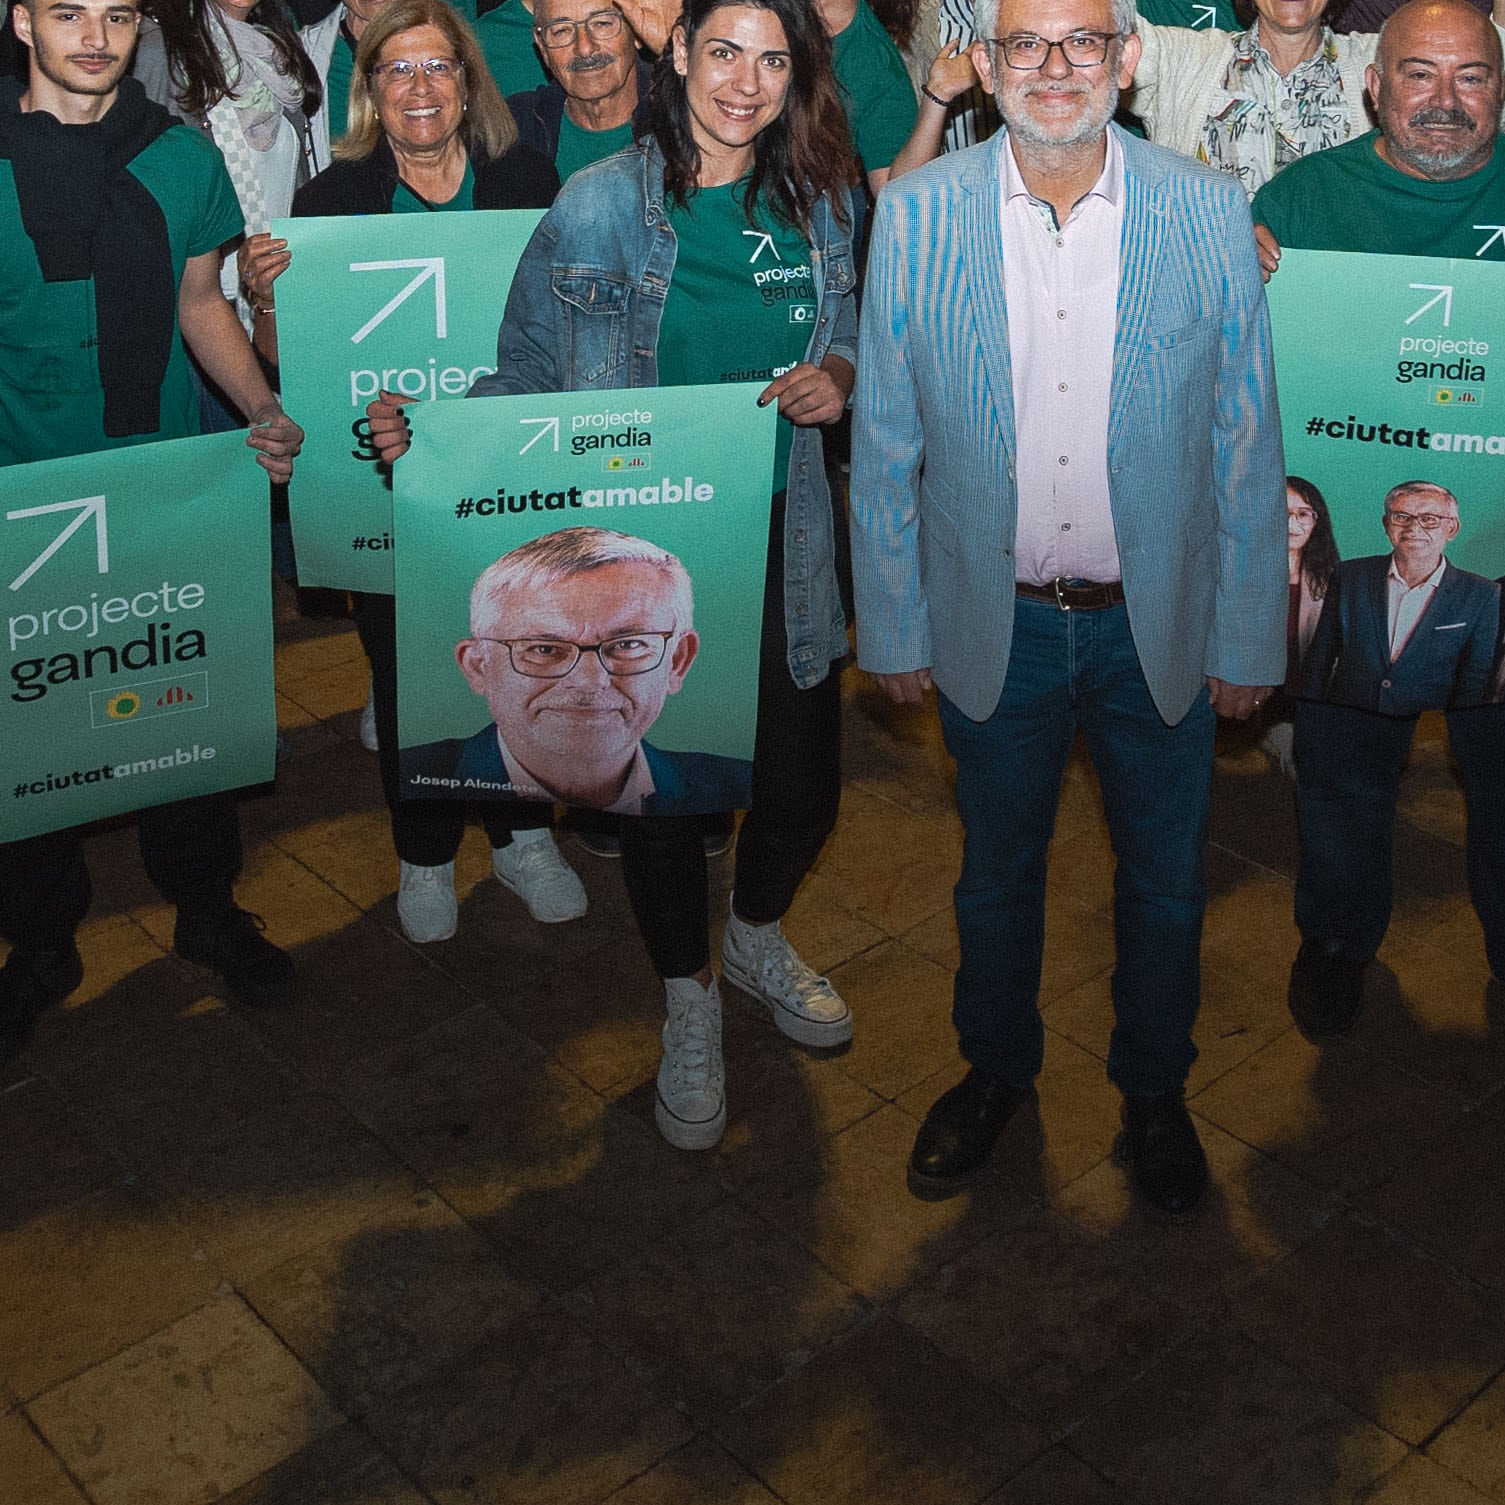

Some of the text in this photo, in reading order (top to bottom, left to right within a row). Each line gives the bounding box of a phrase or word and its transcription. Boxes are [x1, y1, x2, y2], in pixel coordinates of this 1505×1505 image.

[1399, 334, 1490, 362] projecte
[350, 357, 495, 407] projec
[1395, 357, 1486, 384] gandia
[571, 408, 653, 434] projecte
[570, 427, 652, 456] gandia
[454, 477, 715, 520] #ciutatamable
[7, 580, 206, 652] projecte
[10, 621, 208, 704] gandia
[12, 742, 217, 800] #ciutatamable
[410, 774, 539, 794] Josep Alandete
